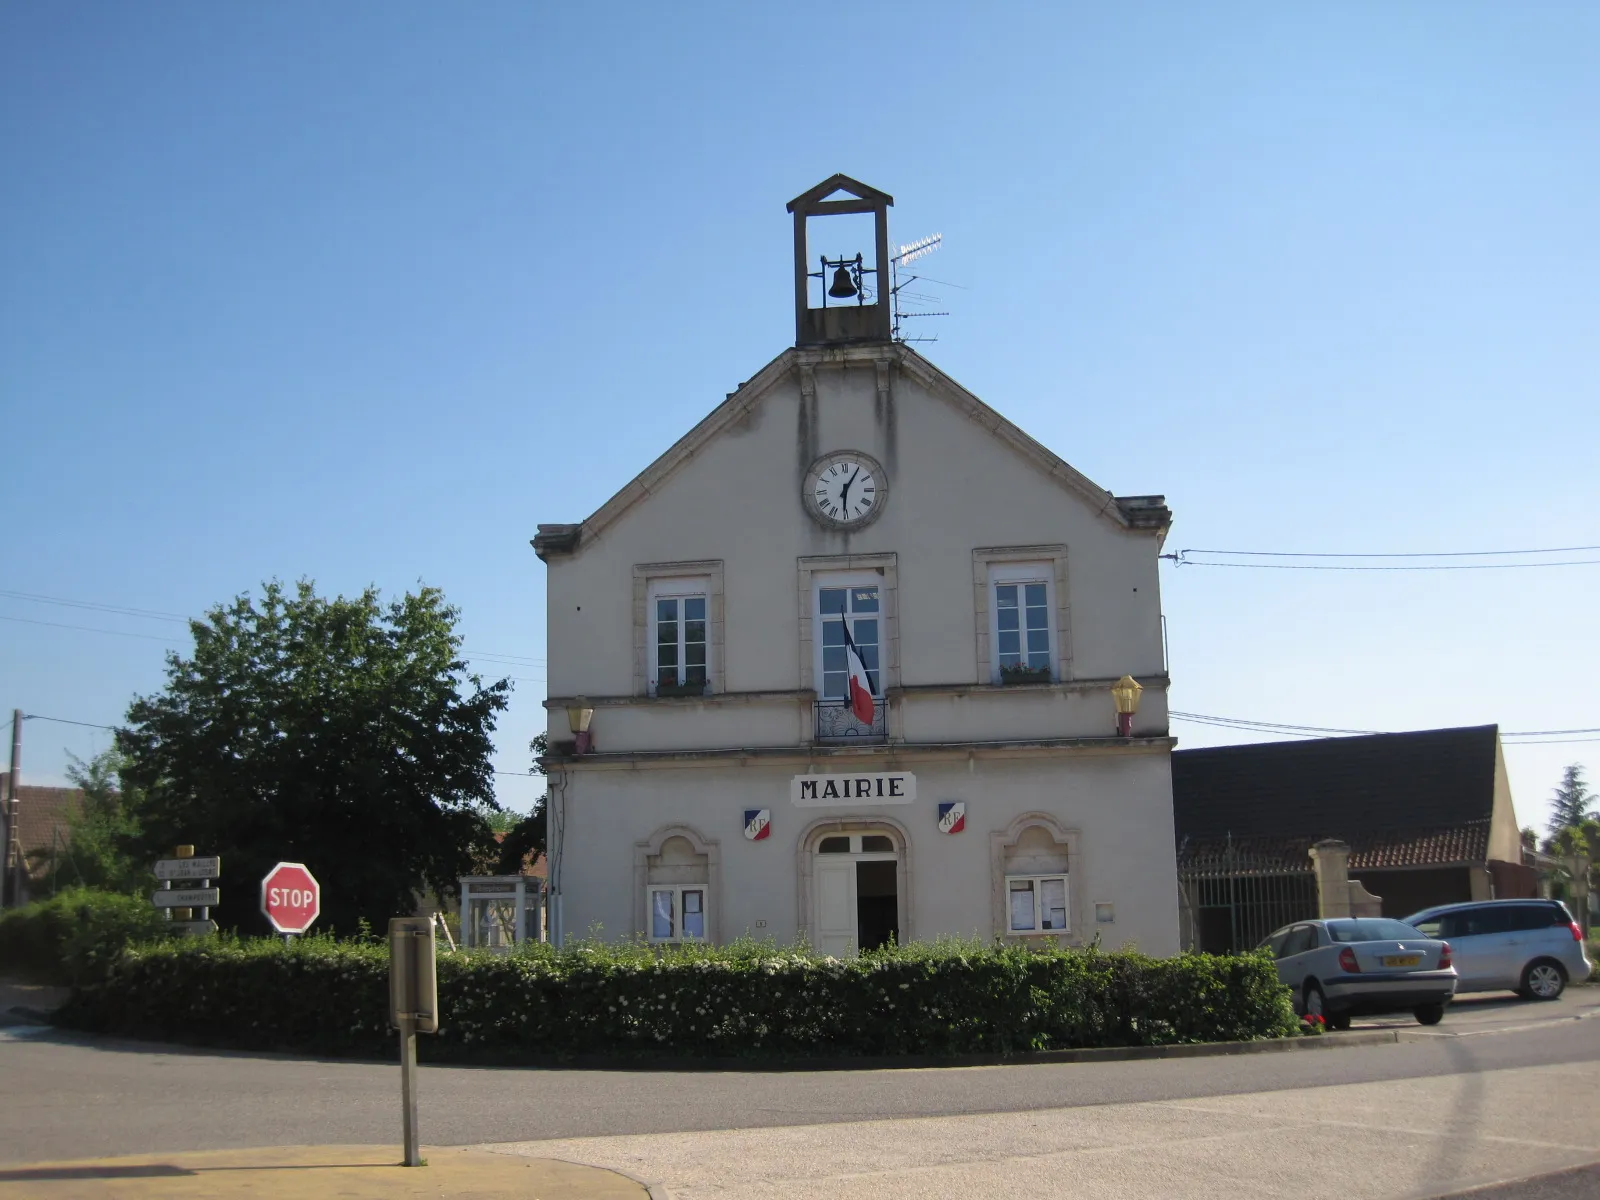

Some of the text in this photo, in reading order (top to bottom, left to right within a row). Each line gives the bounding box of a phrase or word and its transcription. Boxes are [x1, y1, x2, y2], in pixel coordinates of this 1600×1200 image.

[801, 778, 904, 799] MAIRIE
[749, 818, 766, 832] RF
[944, 811, 961, 826] RF
[269, 887, 313, 908] STOP
